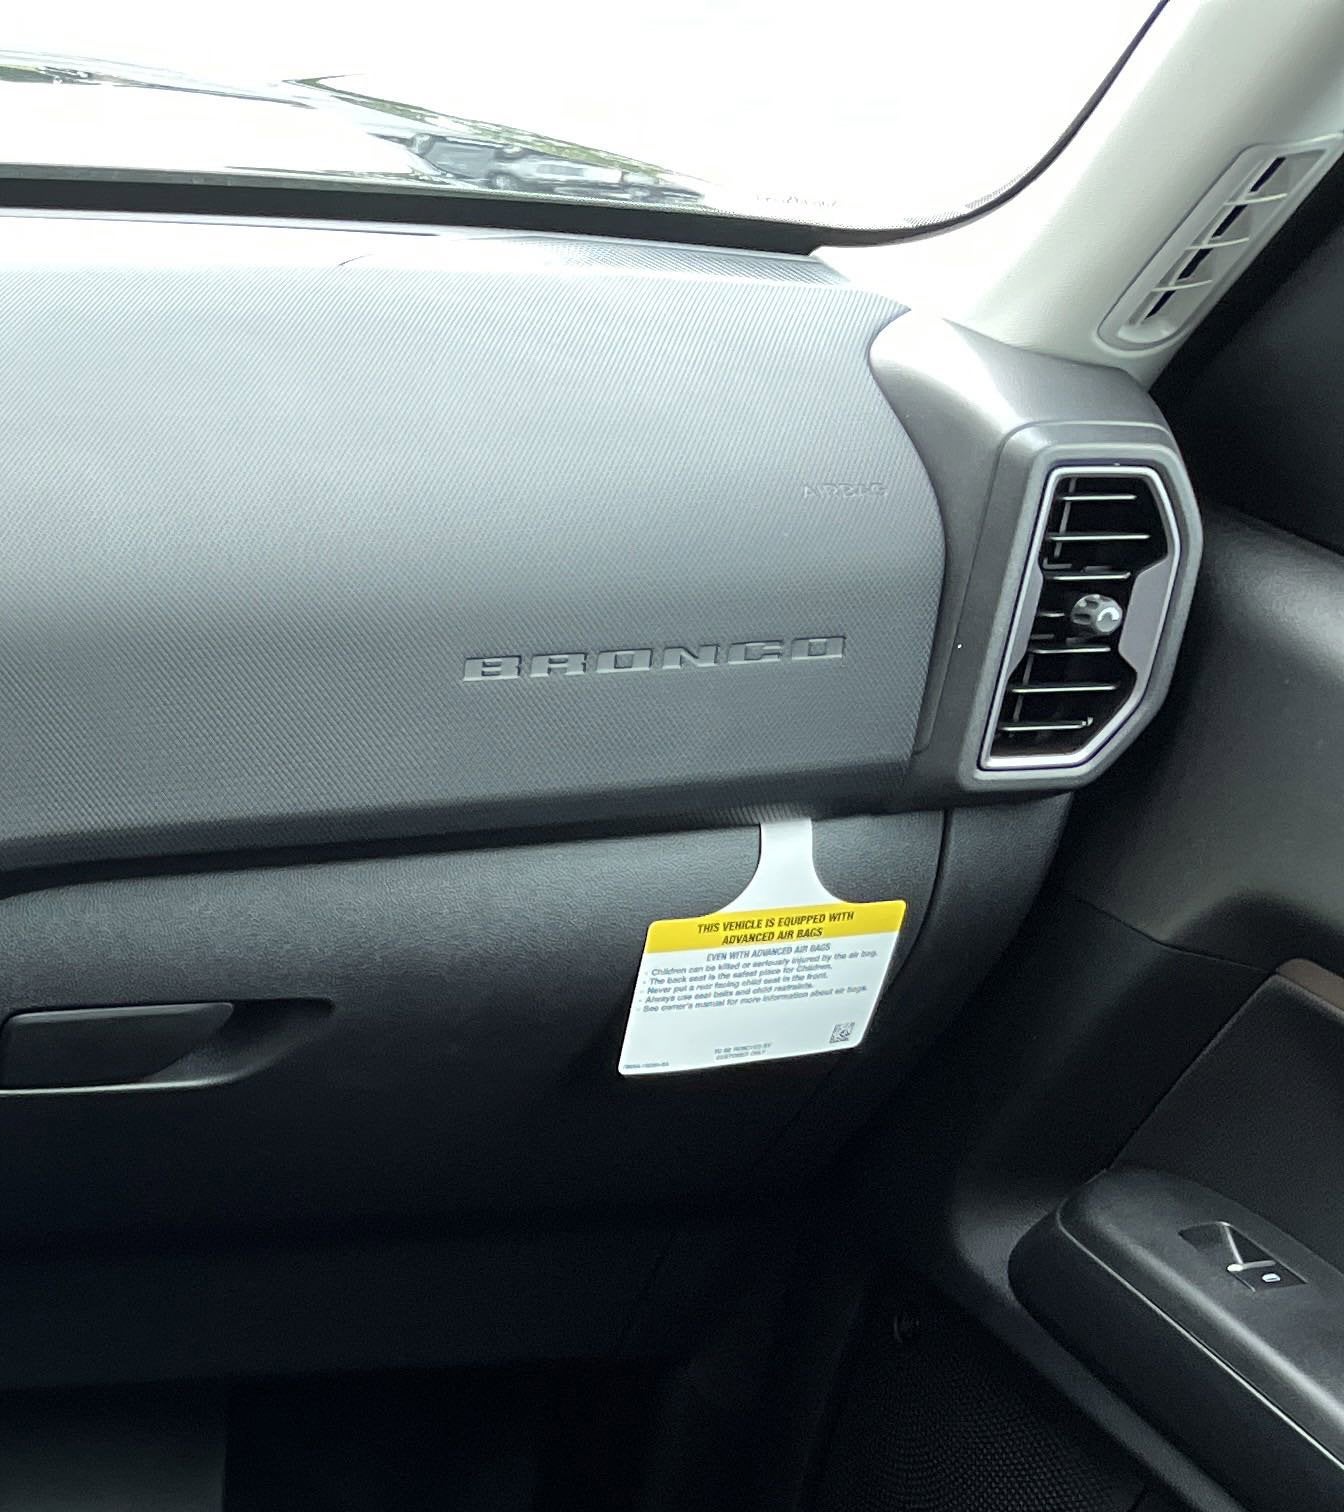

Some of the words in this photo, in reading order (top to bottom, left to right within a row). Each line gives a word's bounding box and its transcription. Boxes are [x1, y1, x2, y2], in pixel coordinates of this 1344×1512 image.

[462, 635, 846, 682] BRONCO
[696, 922, 720, 934] THIS
[722, 919, 763, 933] VEHICLE
[764, 918, 776, 929] IS
[777, 913, 826, 928] EQUIPPED
[828, 911, 855, 924] WITH
[721, 929, 774, 946] ADVANCED
[777, 930, 794, 941] AIR
[797, 927, 824, 938] BAGS
[706, 951, 727, 962] EVEN
[729, 949, 750, 960] WITH
[751, 946, 793, 958] ADVANCED
[794, 945, 809, 953] AIR
